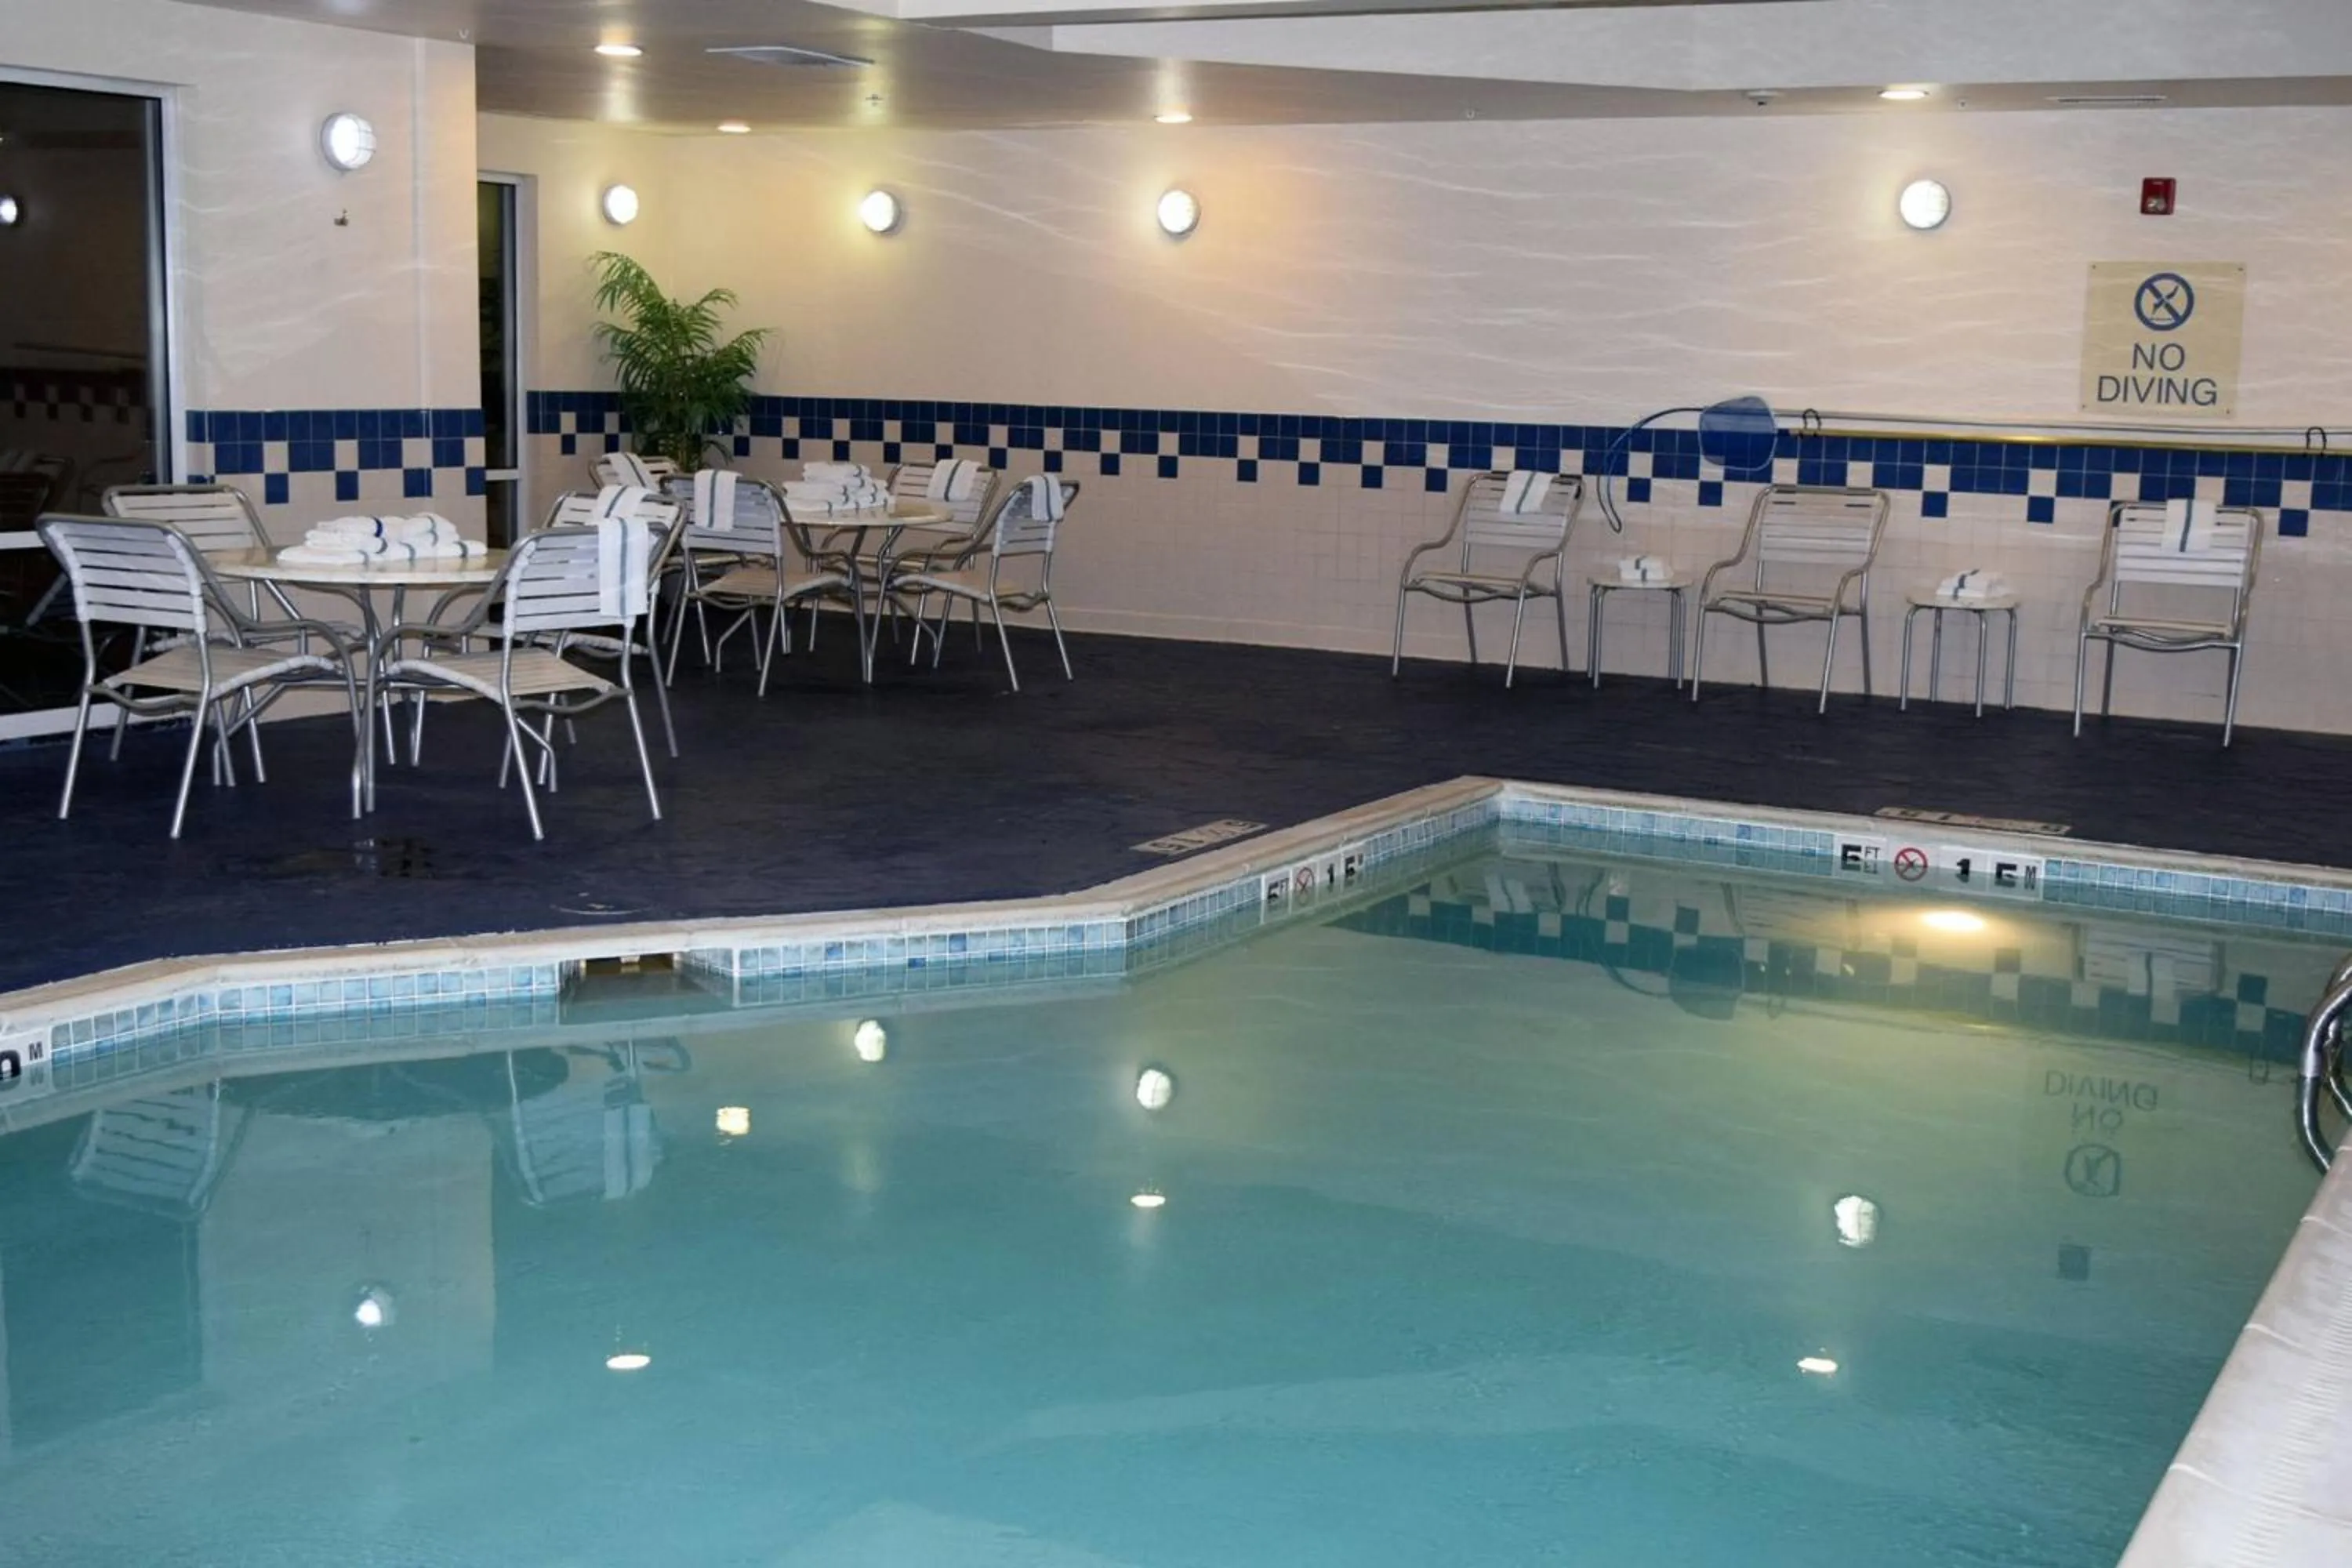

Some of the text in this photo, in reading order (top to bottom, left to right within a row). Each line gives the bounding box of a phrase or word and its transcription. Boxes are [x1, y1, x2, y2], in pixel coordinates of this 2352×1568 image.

[2132, 343, 2186, 371] NO
[2096, 376, 2218, 407] DIVING
[28, 1040, 44, 1061] M
